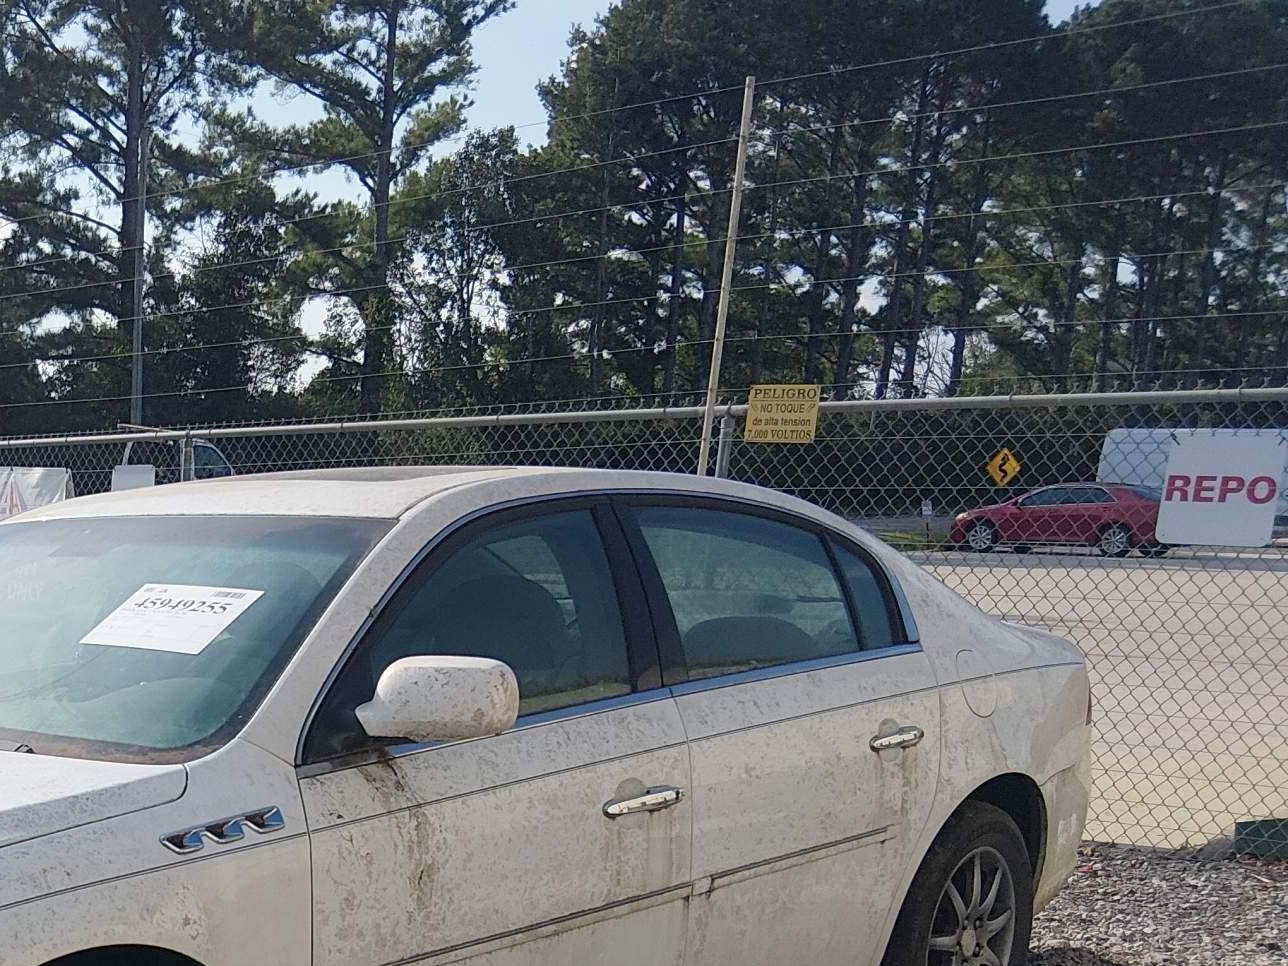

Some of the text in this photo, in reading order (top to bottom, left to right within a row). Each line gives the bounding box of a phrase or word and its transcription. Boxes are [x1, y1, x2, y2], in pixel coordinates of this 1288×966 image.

[753, 388, 817, 399] PELIGRO
[760, 403, 805, 413] NO TOQUE
[752, 417, 811, 426] de alta tension
[747, 429, 812, 440] 7.000 VOLTIOS
[1164, 475, 1277, 504] REPO
[134, 596, 233, 615] 45949255
